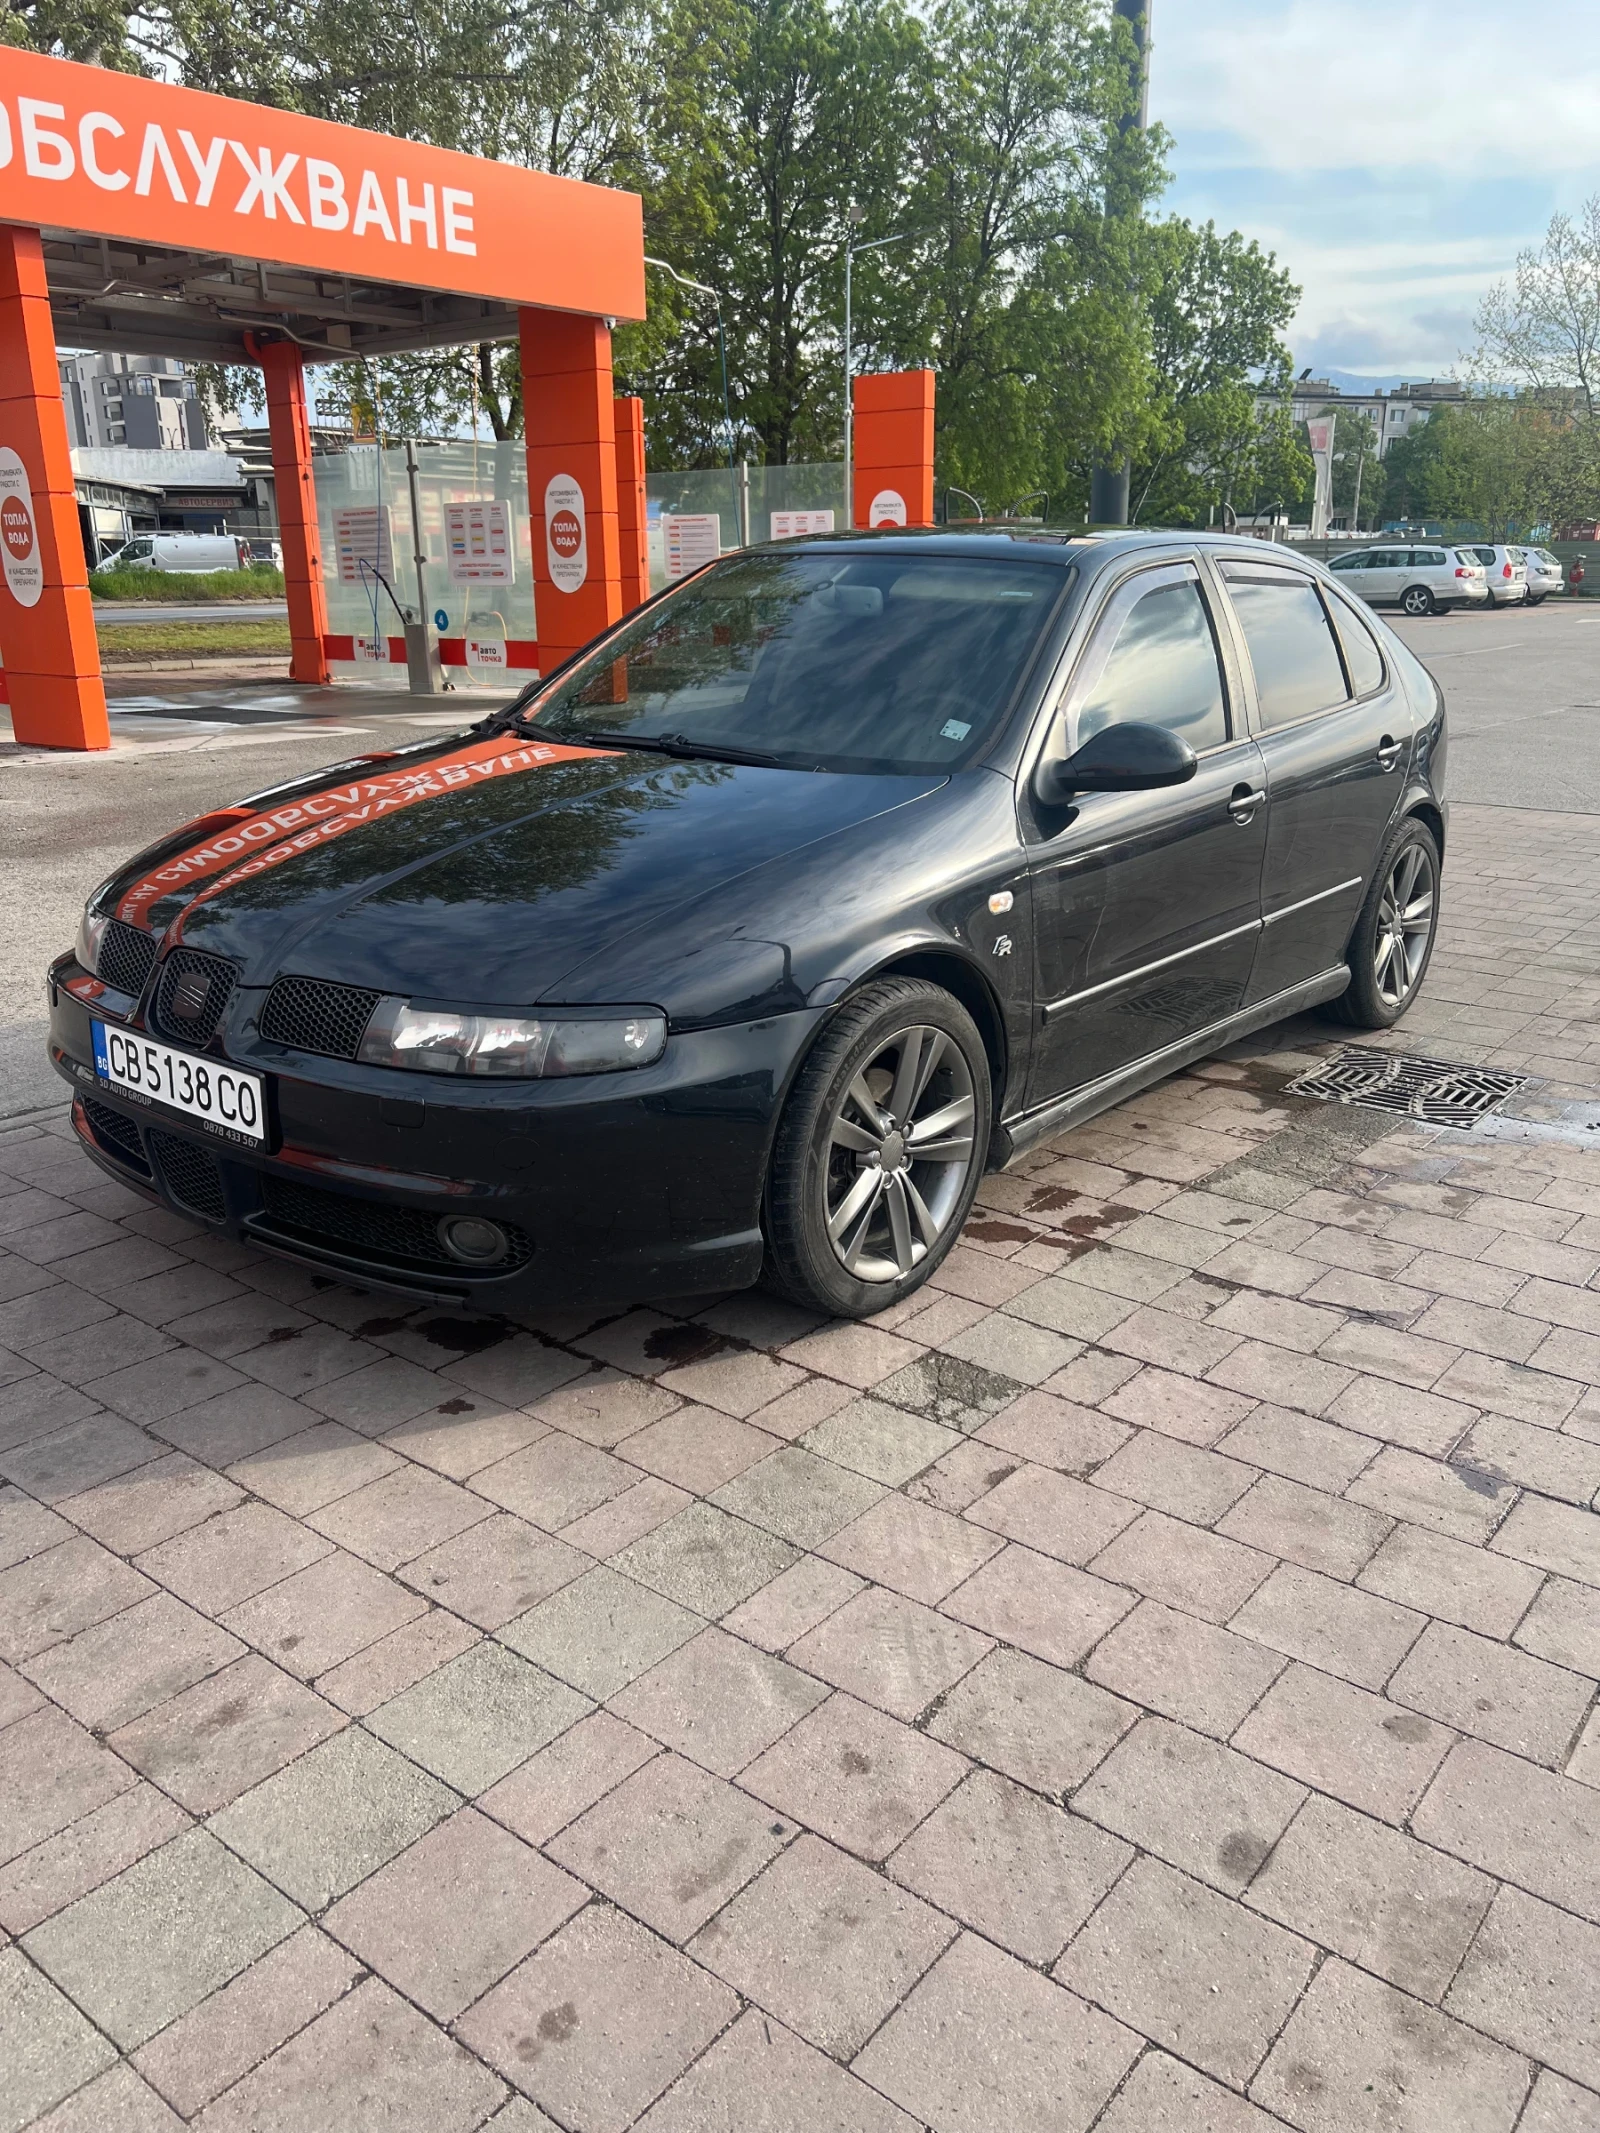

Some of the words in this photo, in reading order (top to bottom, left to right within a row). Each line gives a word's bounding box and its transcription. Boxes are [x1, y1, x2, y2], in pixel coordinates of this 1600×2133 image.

[0, 96, 477, 257] БСЛУЖВАНЕ
[178, 497, 235, 507] АВТОСЕРВИЗ
[3, 513, 29, 526] ТОПЛА
[553, 522, 578, 533] ТОПЛА
[8, 532, 29, 546] ВОДА
[556, 536, 577, 547] ВОДА
[438, 614, 445, 626] 4
[479, 647, 497, 655] авто
[480, 655, 502, 663] точка
[97, 1055, 108, 1071] BG
[832, 1035, 870, 1093] Matador
[99, 1077, 109, 1089] SD
[109, 1081, 128, 1097] AUTO
[127, 1088, 152, 1107] GROUP
[203, 1120, 224, 1137] 0878
[225, 1129, 242, 1143] 433
[242, 1134, 259, 1149] 567
